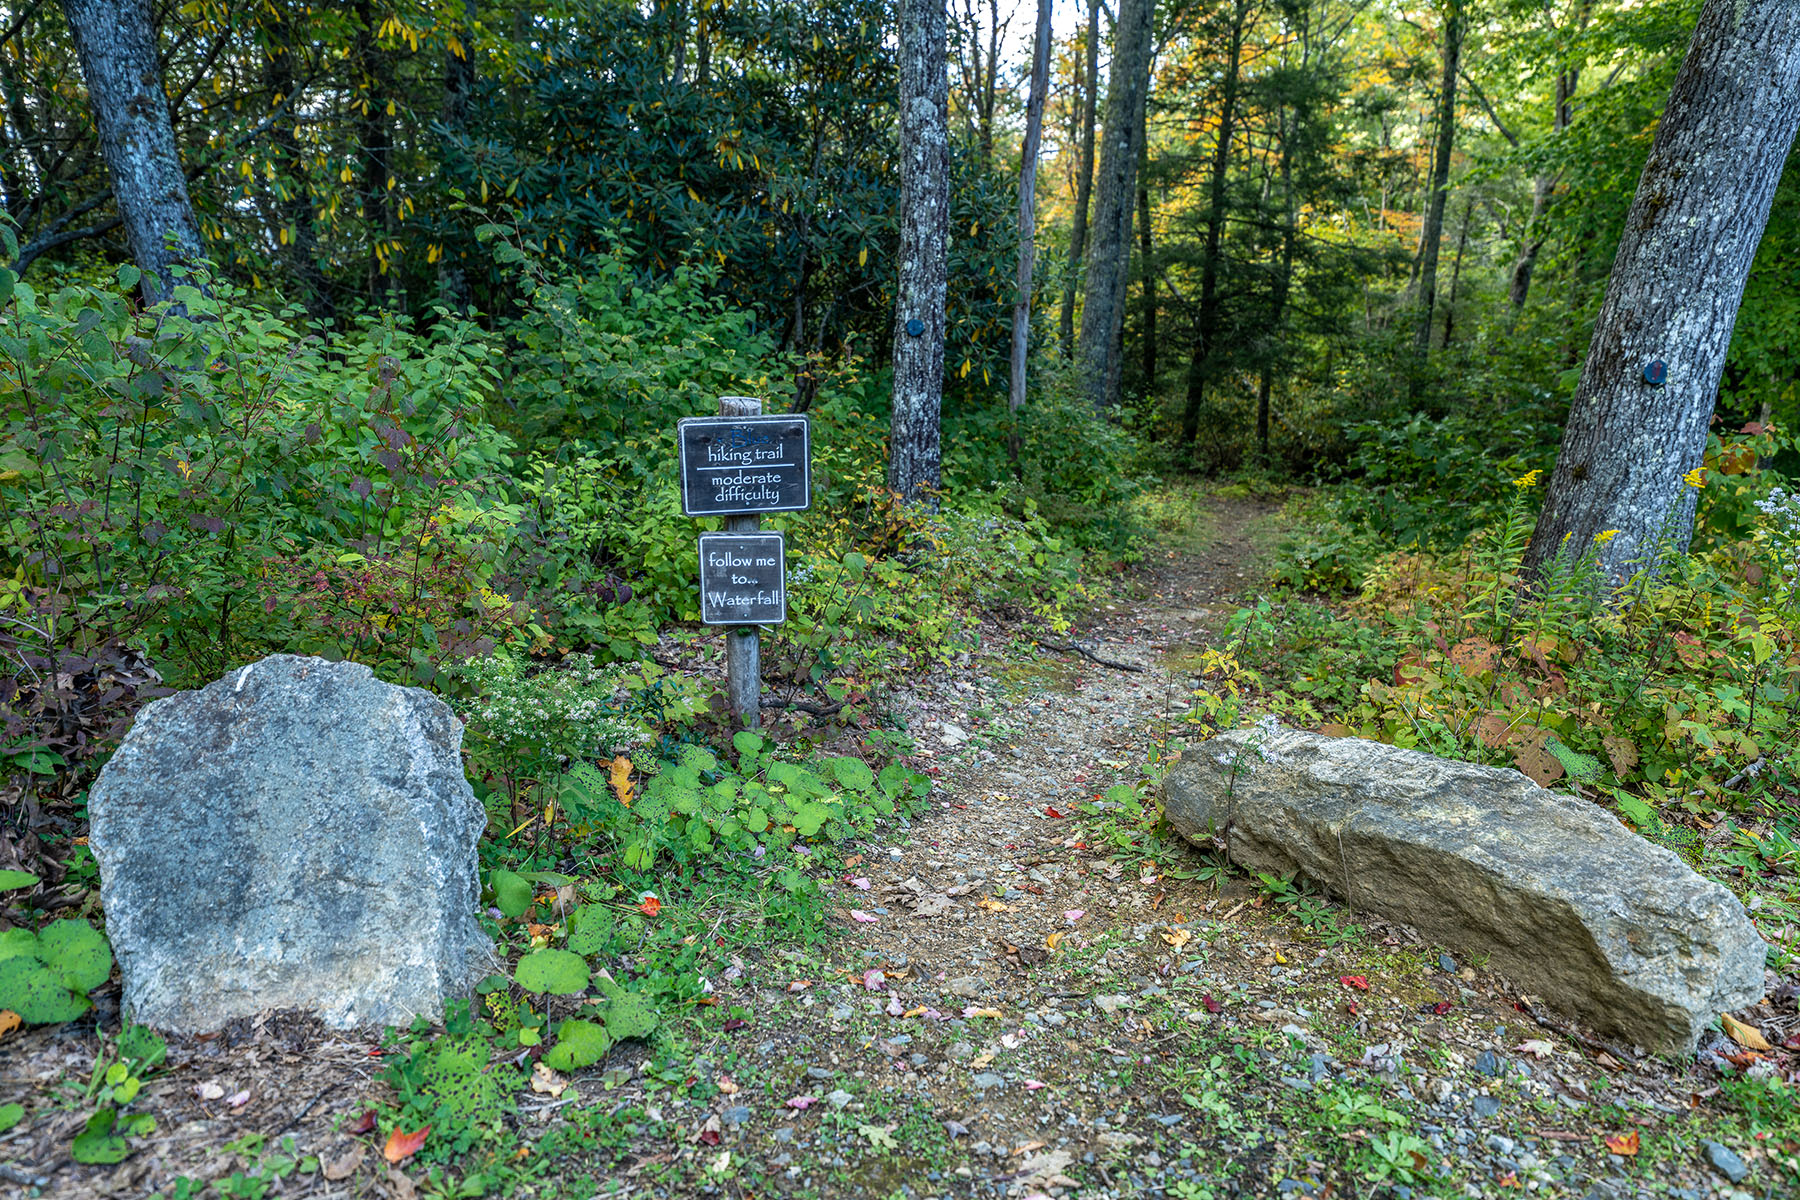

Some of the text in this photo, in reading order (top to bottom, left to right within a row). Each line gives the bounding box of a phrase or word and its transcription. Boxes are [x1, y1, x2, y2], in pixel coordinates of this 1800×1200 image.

[730, 429, 769, 449] Blue
[708, 443, 784, 465] hiking trail
[711, 469, 782, 486] moderate
[715, 484, 780, 505] difficulty
[708, 551, 776, 567] follow me
[707, 590, 779, 608] Waterfall
